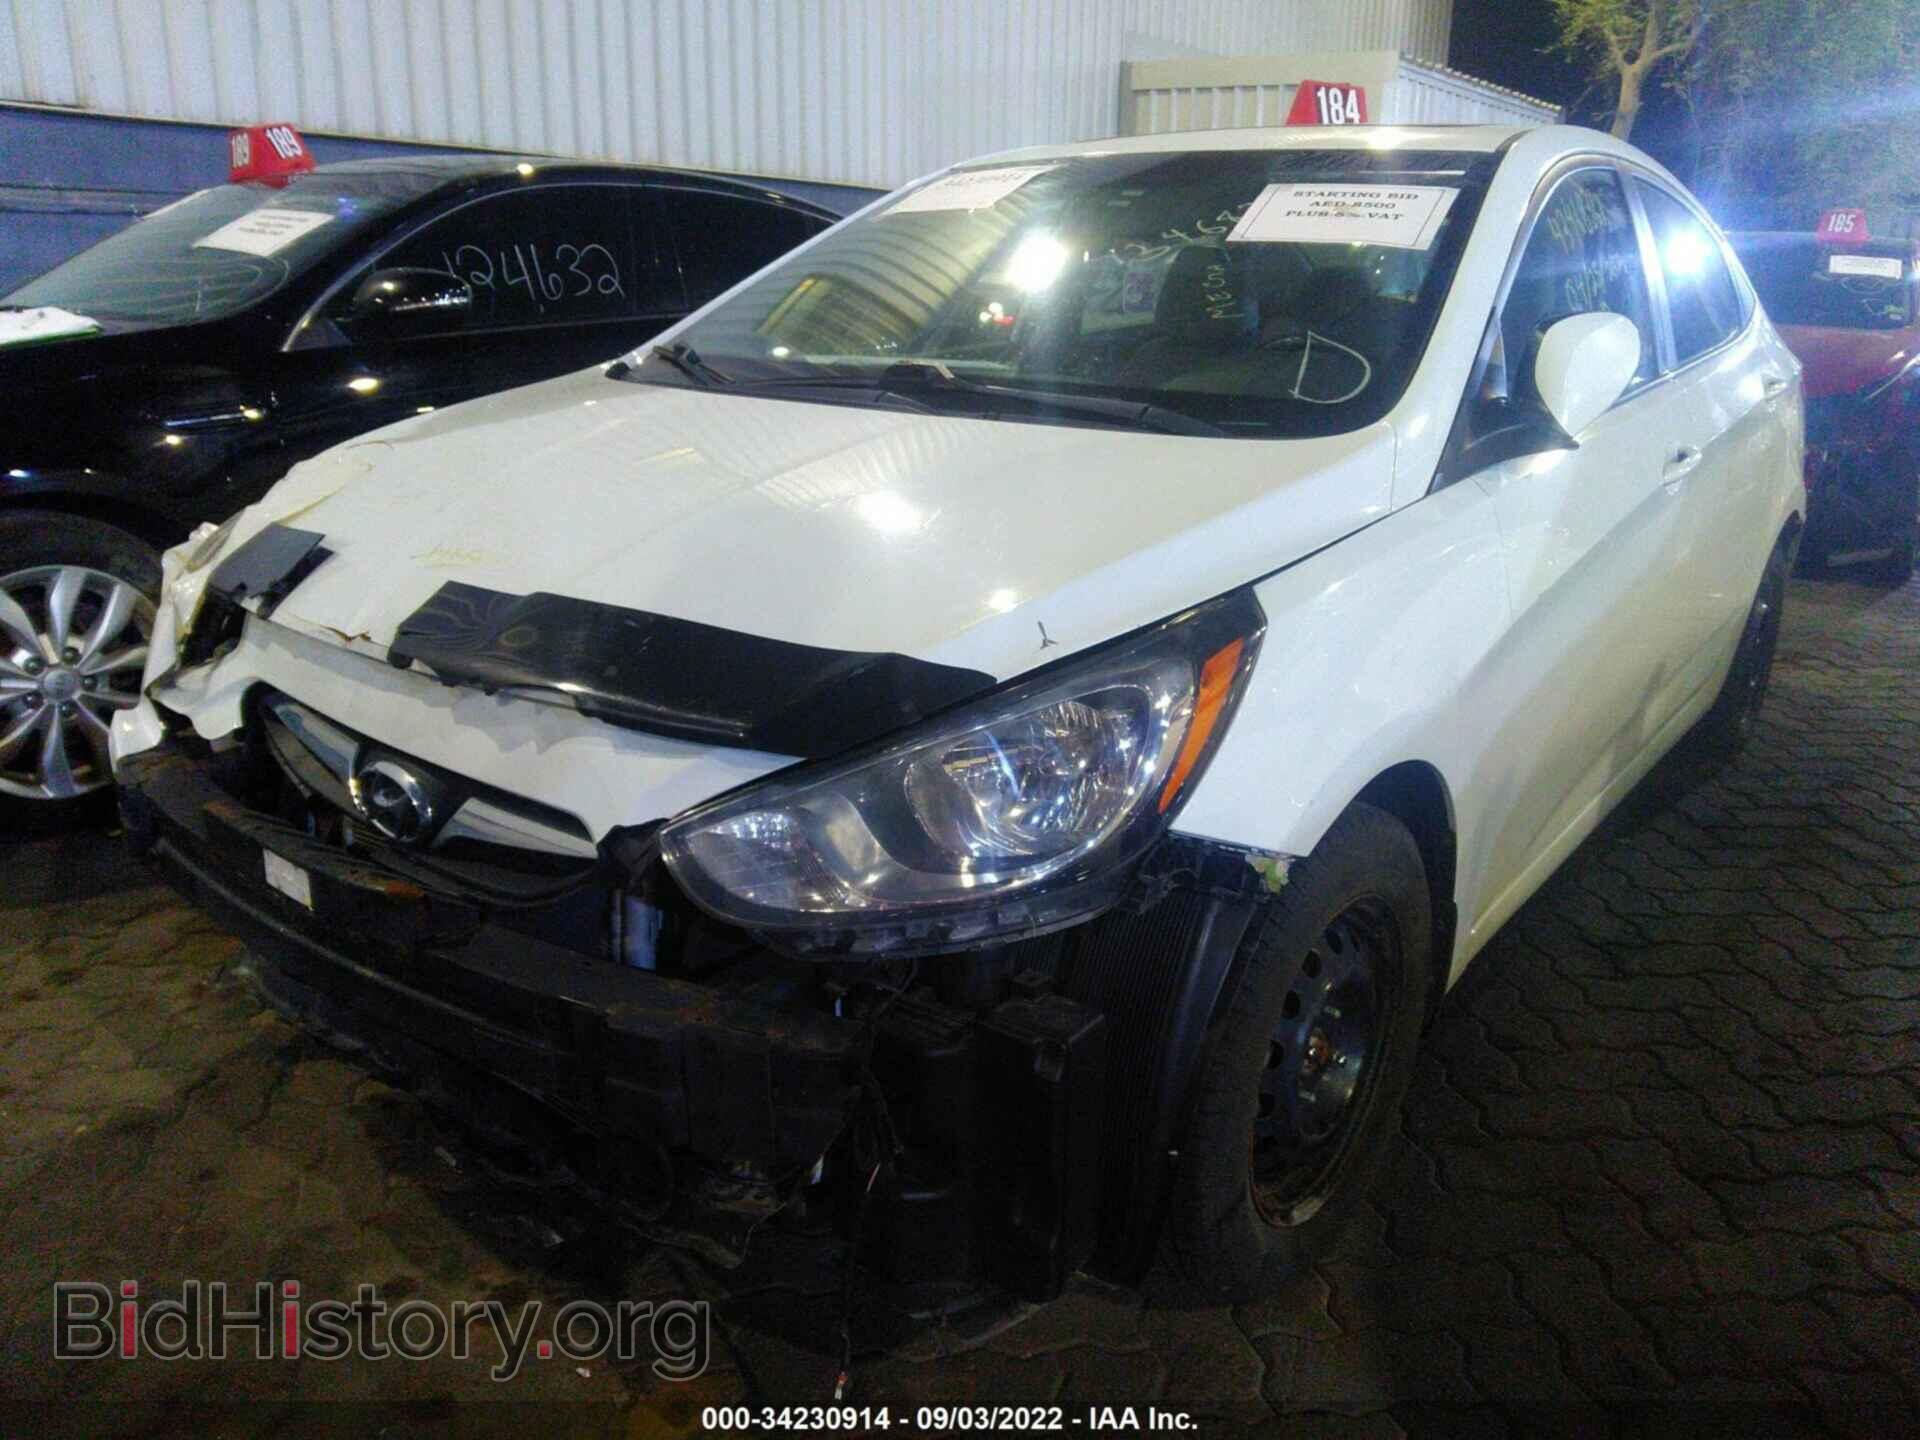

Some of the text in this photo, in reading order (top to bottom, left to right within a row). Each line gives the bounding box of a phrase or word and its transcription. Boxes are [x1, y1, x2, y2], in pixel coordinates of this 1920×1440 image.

[1316, 86, 1360, 125] 184
[265, 126, 303, 159] 189
[1367, 212, 1405, 220] VAT
[1827, 213, 1856, 233] 185
